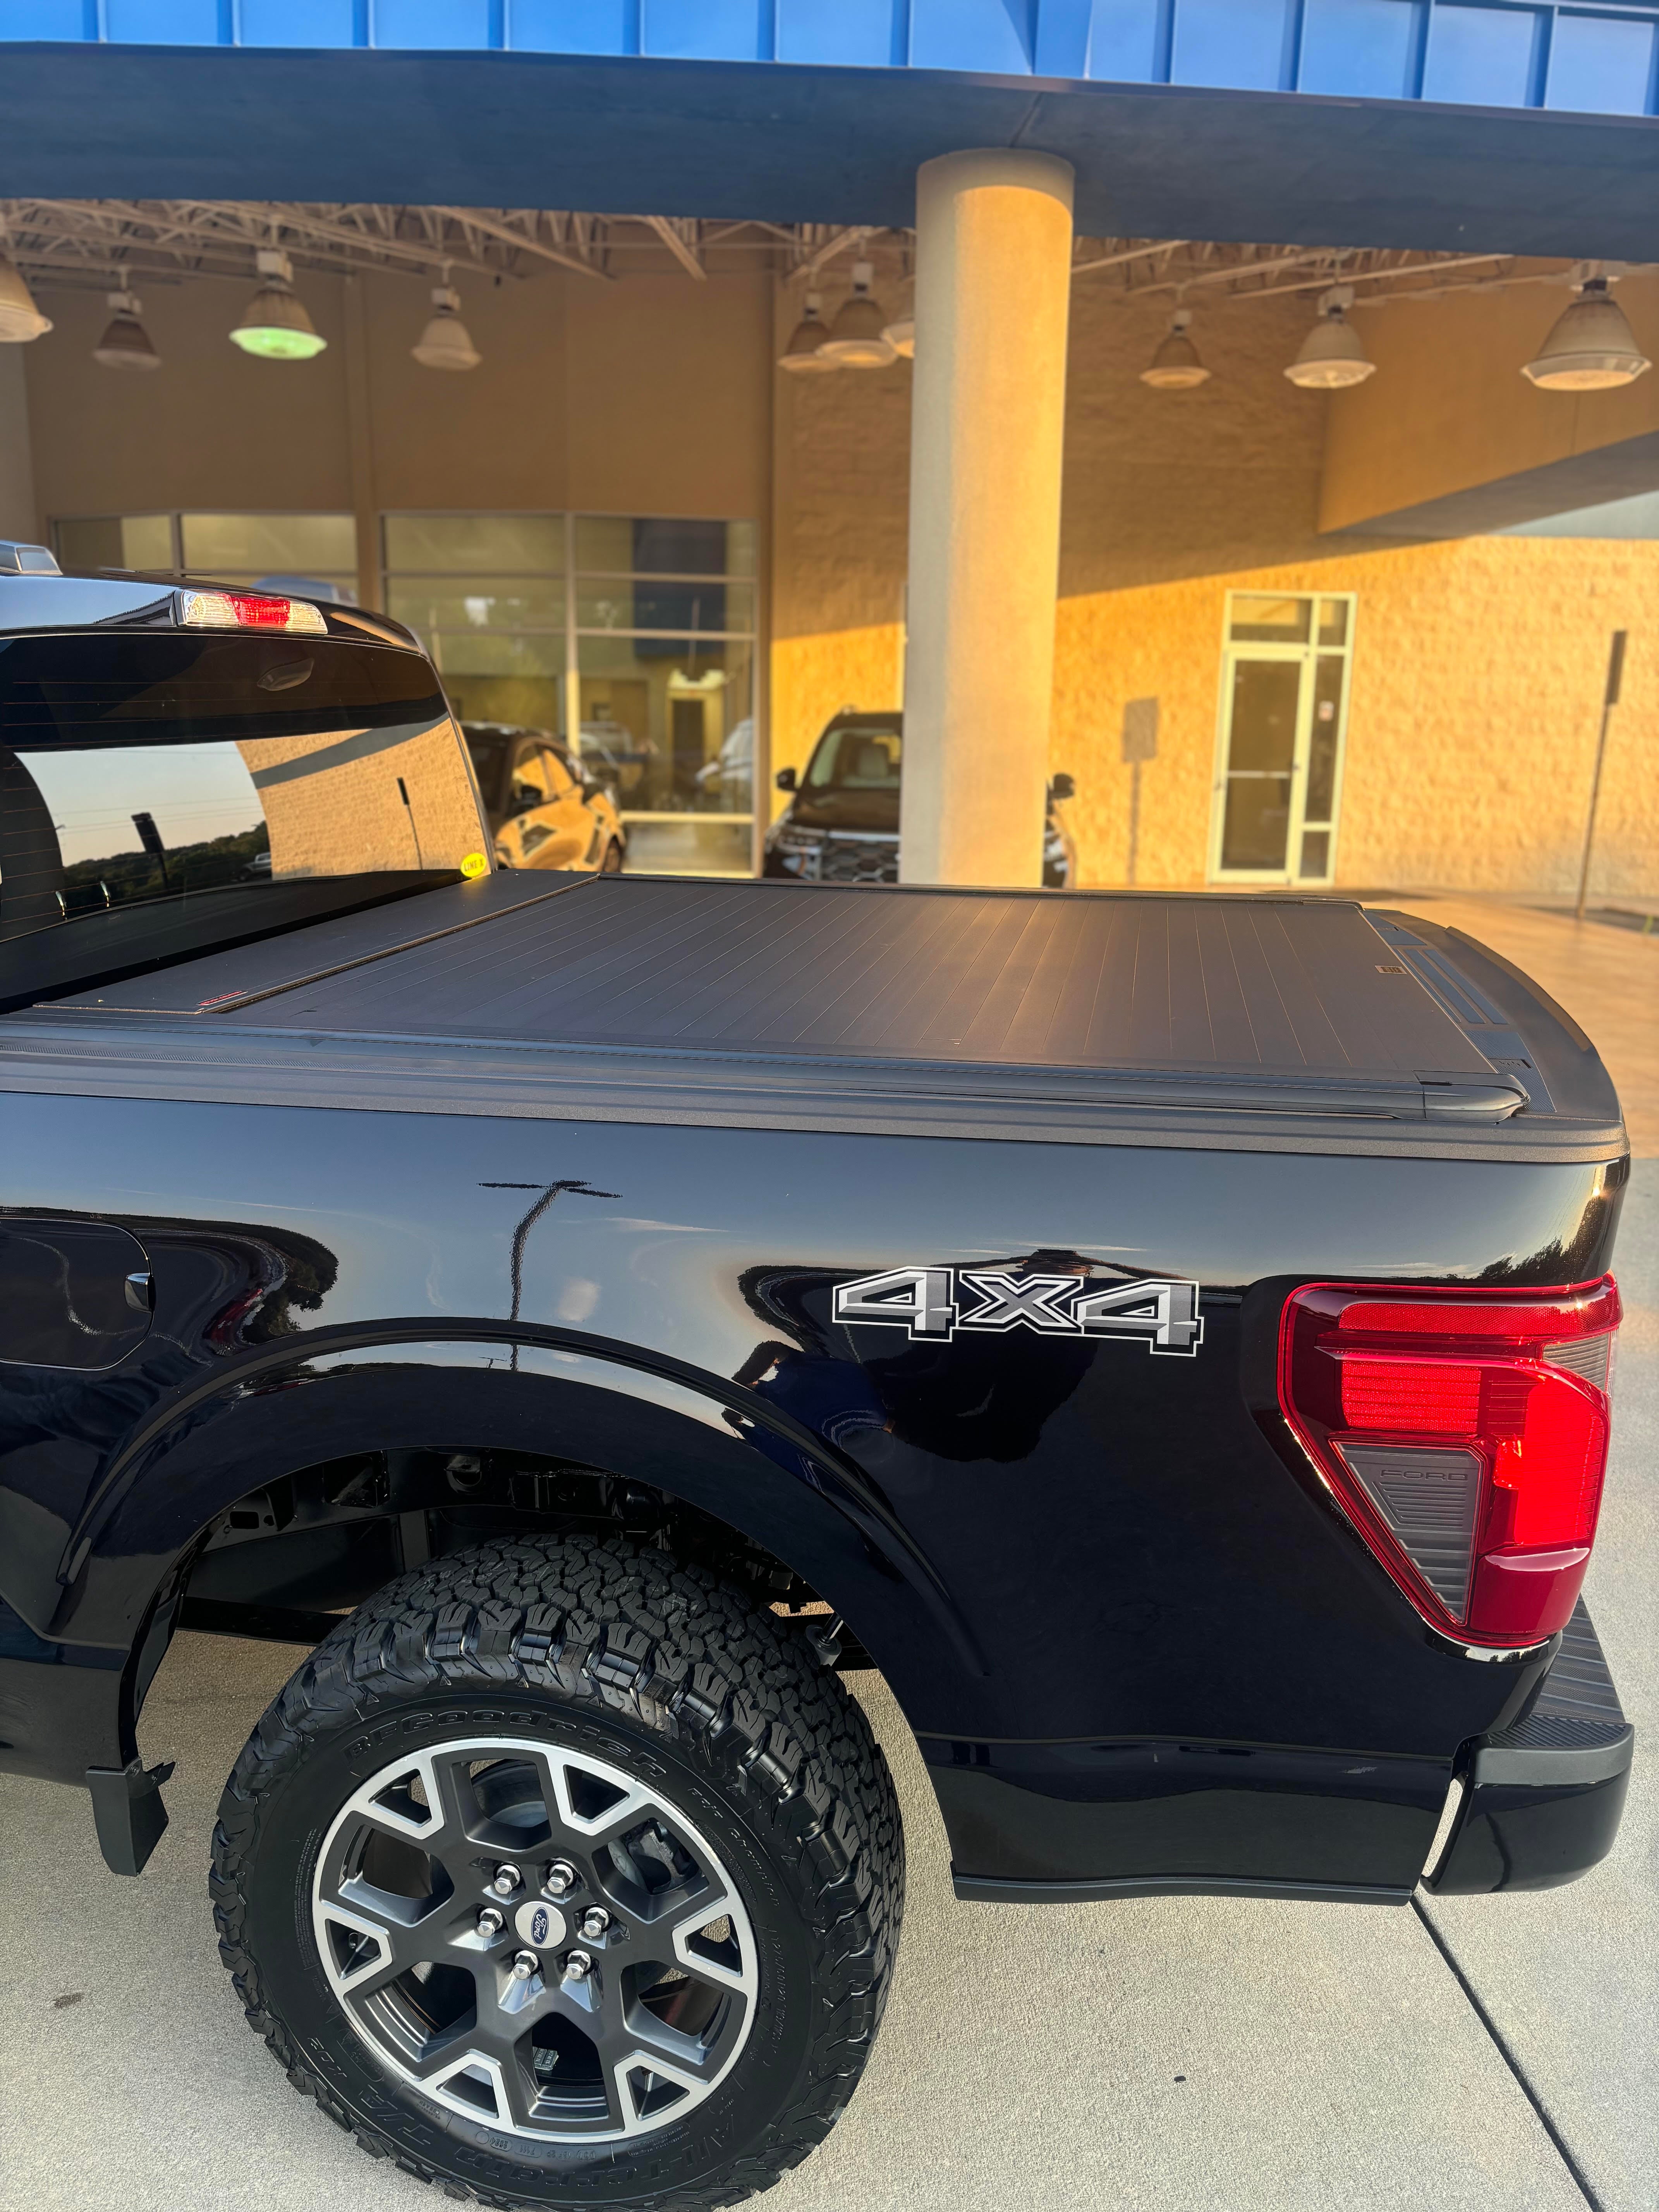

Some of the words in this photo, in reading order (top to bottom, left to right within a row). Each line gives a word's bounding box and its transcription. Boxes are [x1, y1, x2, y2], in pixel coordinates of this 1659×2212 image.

[464, 860, 477, 871] LINE
[1381, 1470, 1468, 1481] FORD
[341, 1709, 667, 1778] BFGoodrich
[687, 1787, 724, 1818] Baja
